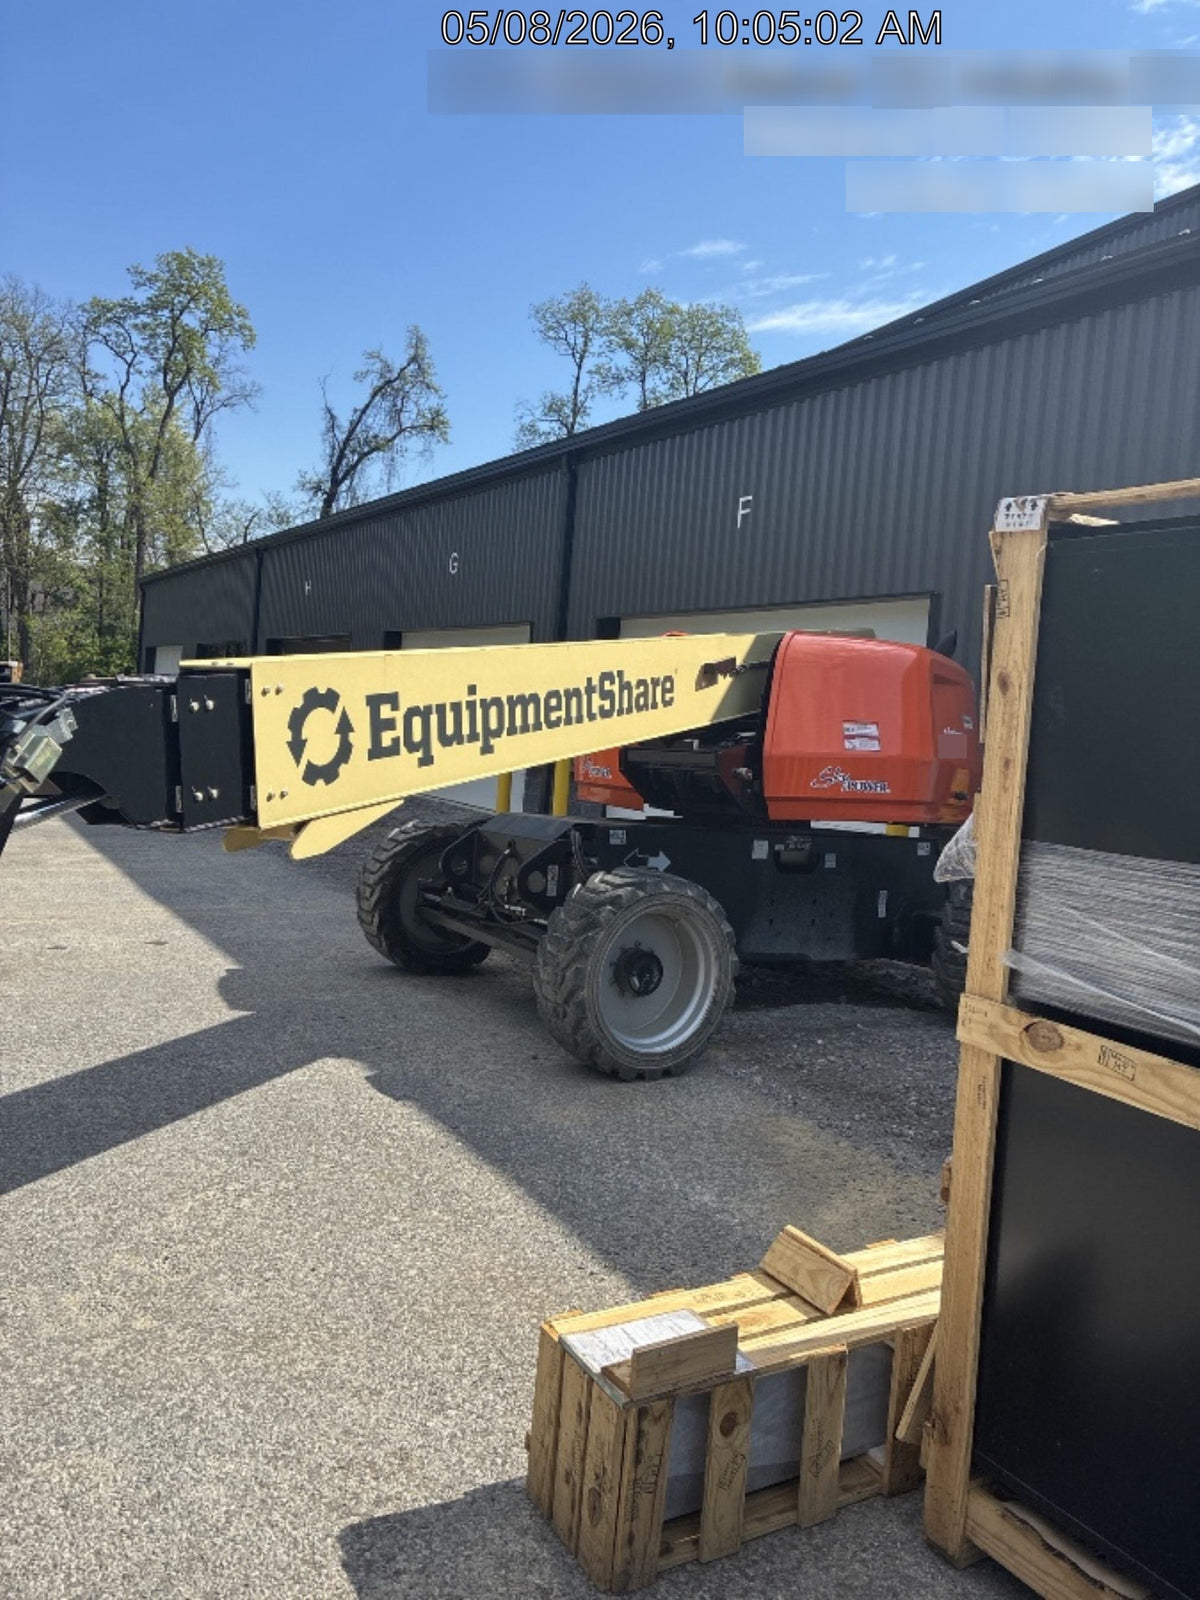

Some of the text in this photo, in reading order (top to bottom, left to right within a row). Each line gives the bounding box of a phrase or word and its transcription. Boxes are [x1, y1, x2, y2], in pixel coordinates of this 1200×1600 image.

[737, 495, 753, 529] F
[449, 552, 459, 575] G
[305, 579, 312, 596] H
[365, 669, 675, 768] EquipmentShare
